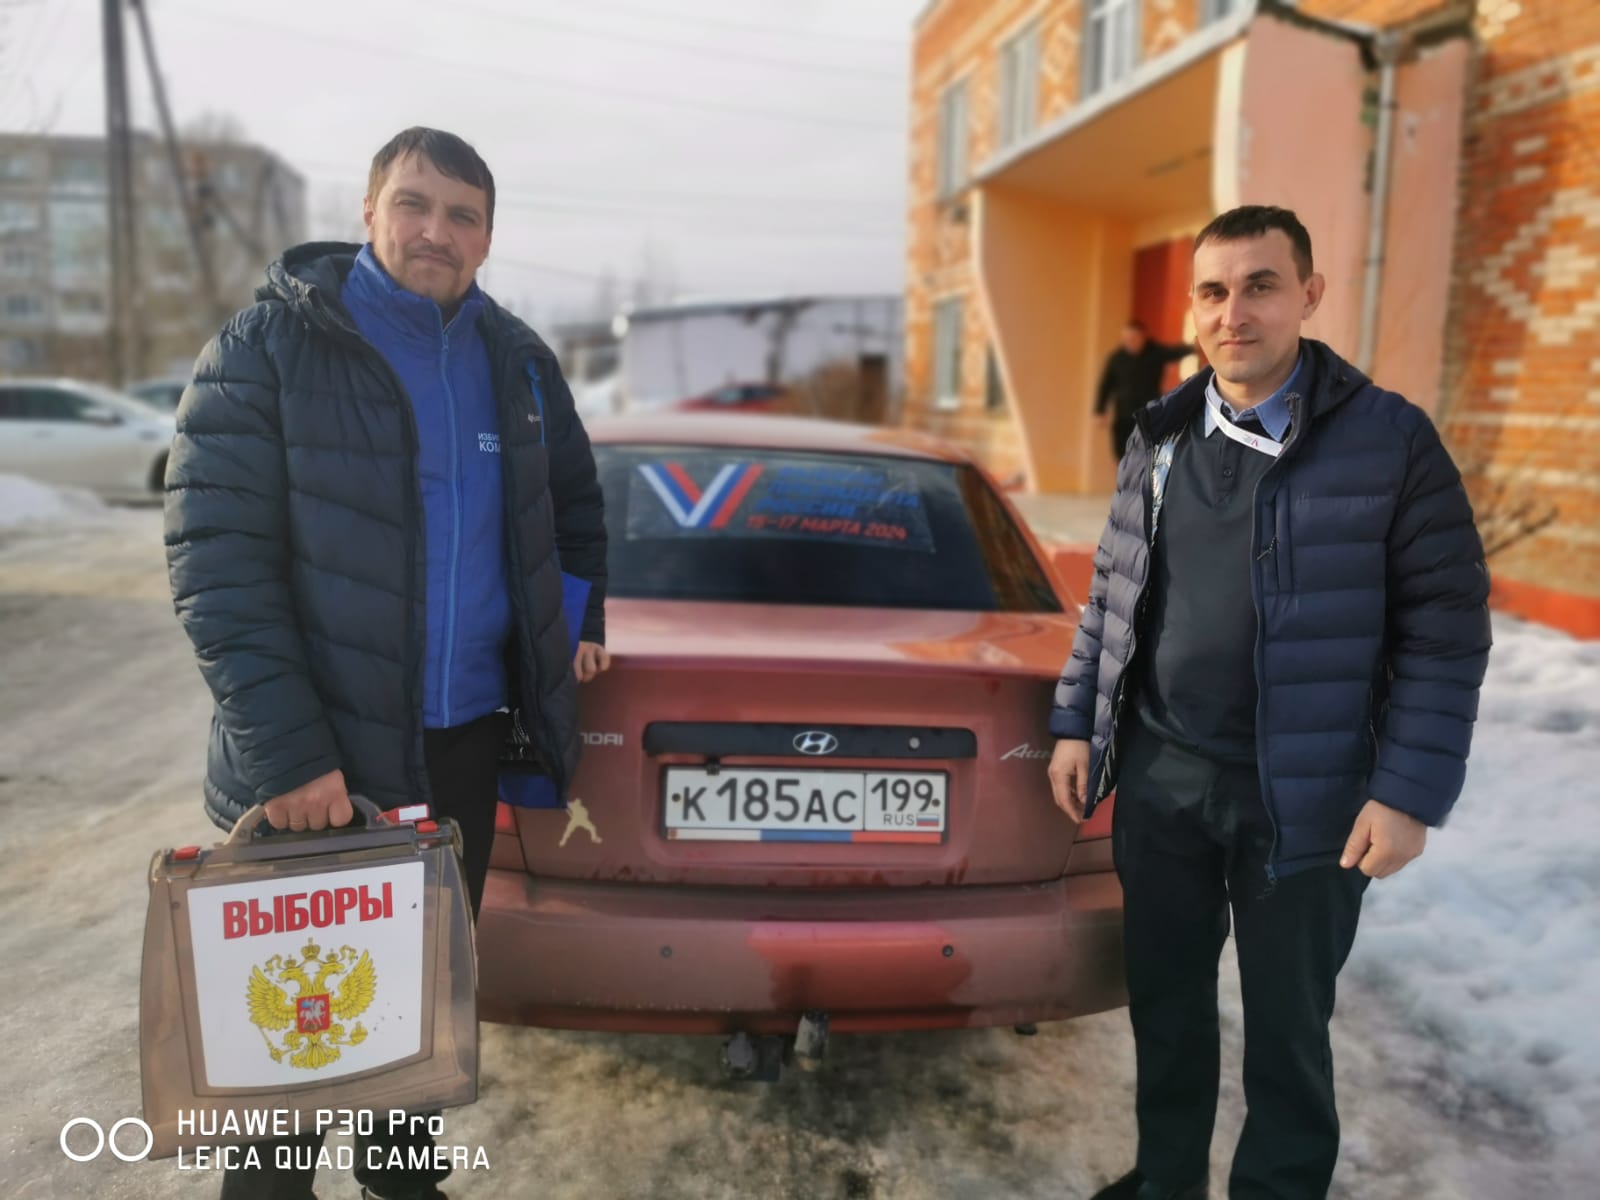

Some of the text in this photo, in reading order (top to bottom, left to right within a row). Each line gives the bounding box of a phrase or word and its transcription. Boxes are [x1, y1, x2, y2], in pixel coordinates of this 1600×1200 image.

[800, 516, 861, 536] МАРТА
[871, 778, 934, 812] 199
[883, 813, 915, 825] RUS
[223, 882, 393, 940] ВЫБОРЫ
